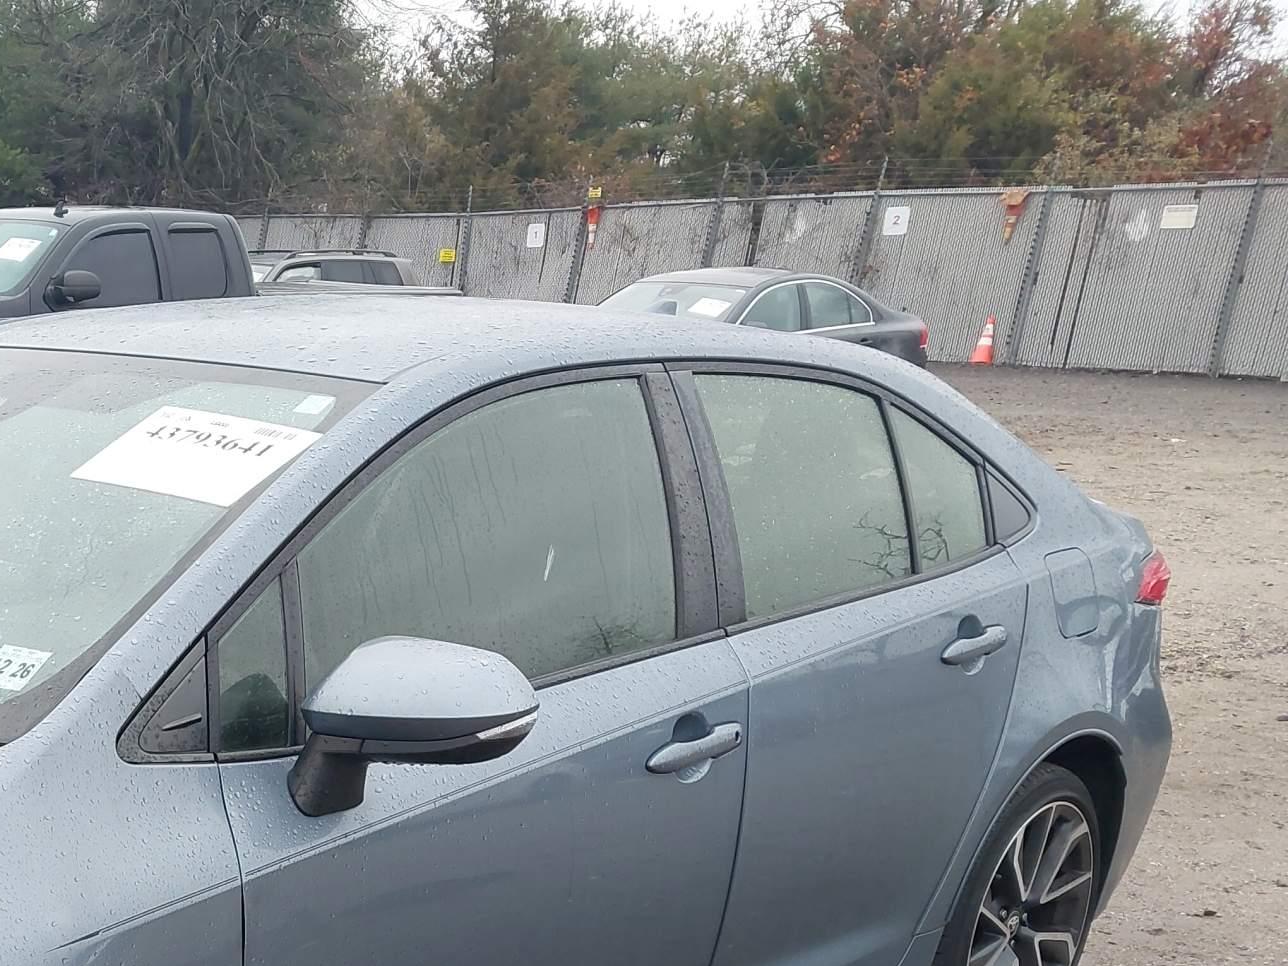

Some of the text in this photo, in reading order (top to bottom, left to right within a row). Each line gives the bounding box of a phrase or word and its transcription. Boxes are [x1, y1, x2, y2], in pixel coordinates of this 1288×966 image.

[892, 215, 901, 225] 2
[146, 426, 274, 457] 43793641
[9, 662, 36, 679] 26
